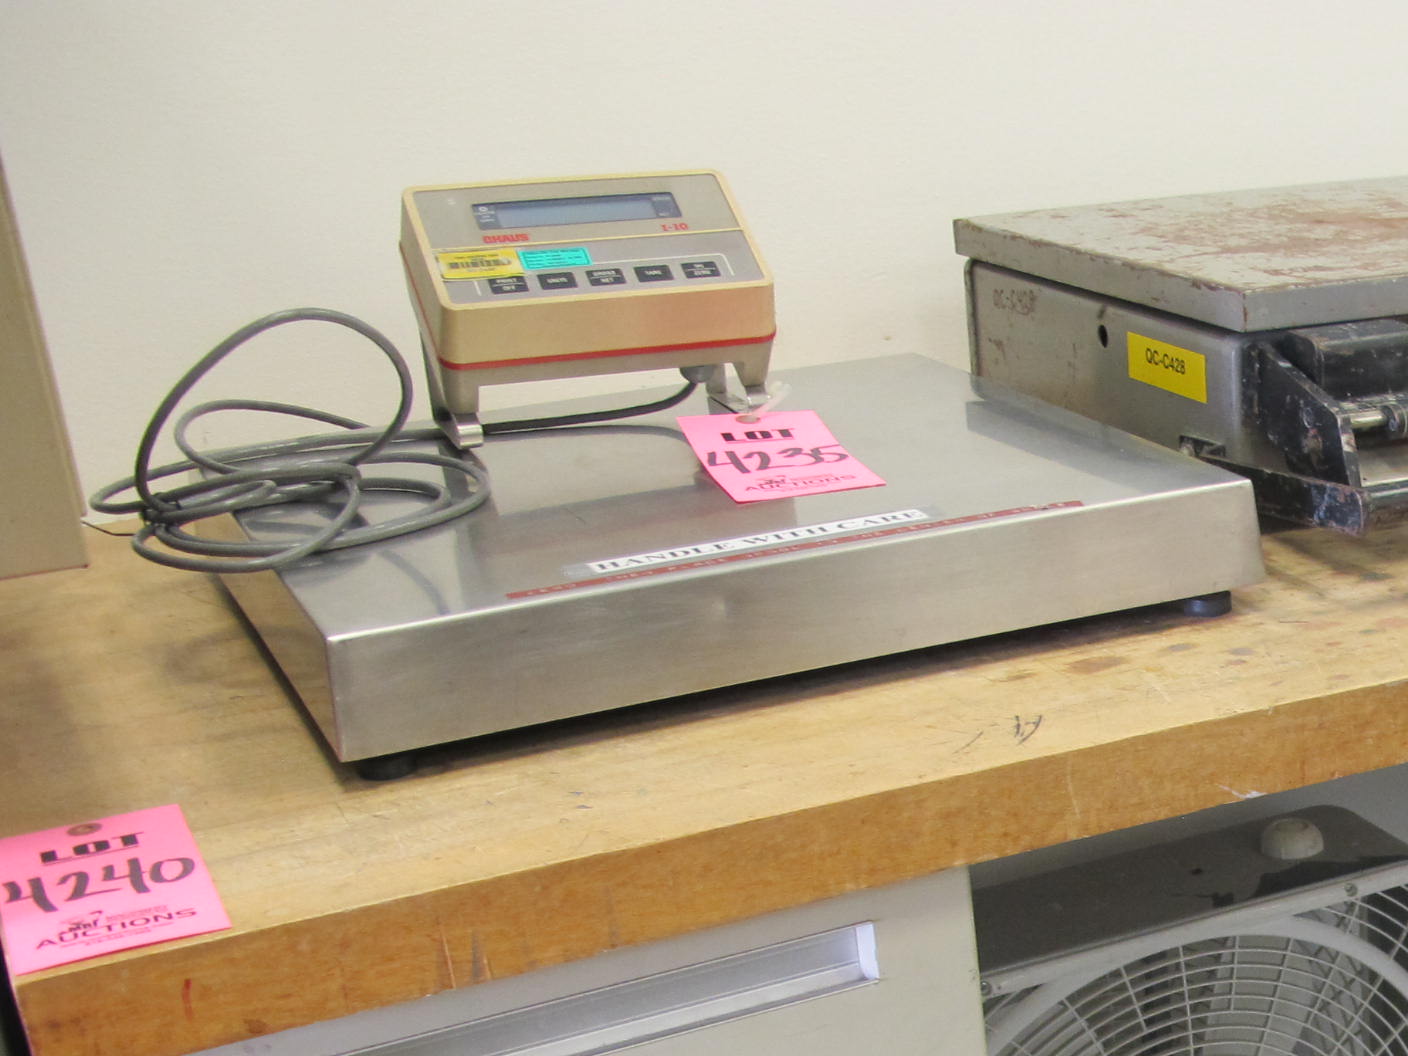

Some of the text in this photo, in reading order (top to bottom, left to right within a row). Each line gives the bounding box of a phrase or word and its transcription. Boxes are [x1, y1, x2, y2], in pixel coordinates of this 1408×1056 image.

[482, 233, 530, 244] OHAUS
[1145, 347, 1186, 375] QC-C428
[720, 428, 794, 442] LOT
[707, 444, 849, 474] 4235
[744, 475, 857, 492] AUCTIONS
[598, 543, 736, 571] HANDLE
[742, 523, 832, 545] WITH
[837, 509, 925, 530] CARE
[40, 832, 144, 866] LOT
[2, 857, 195, 913] 4240
[36, 907, 197, 950] AUCTIONS
